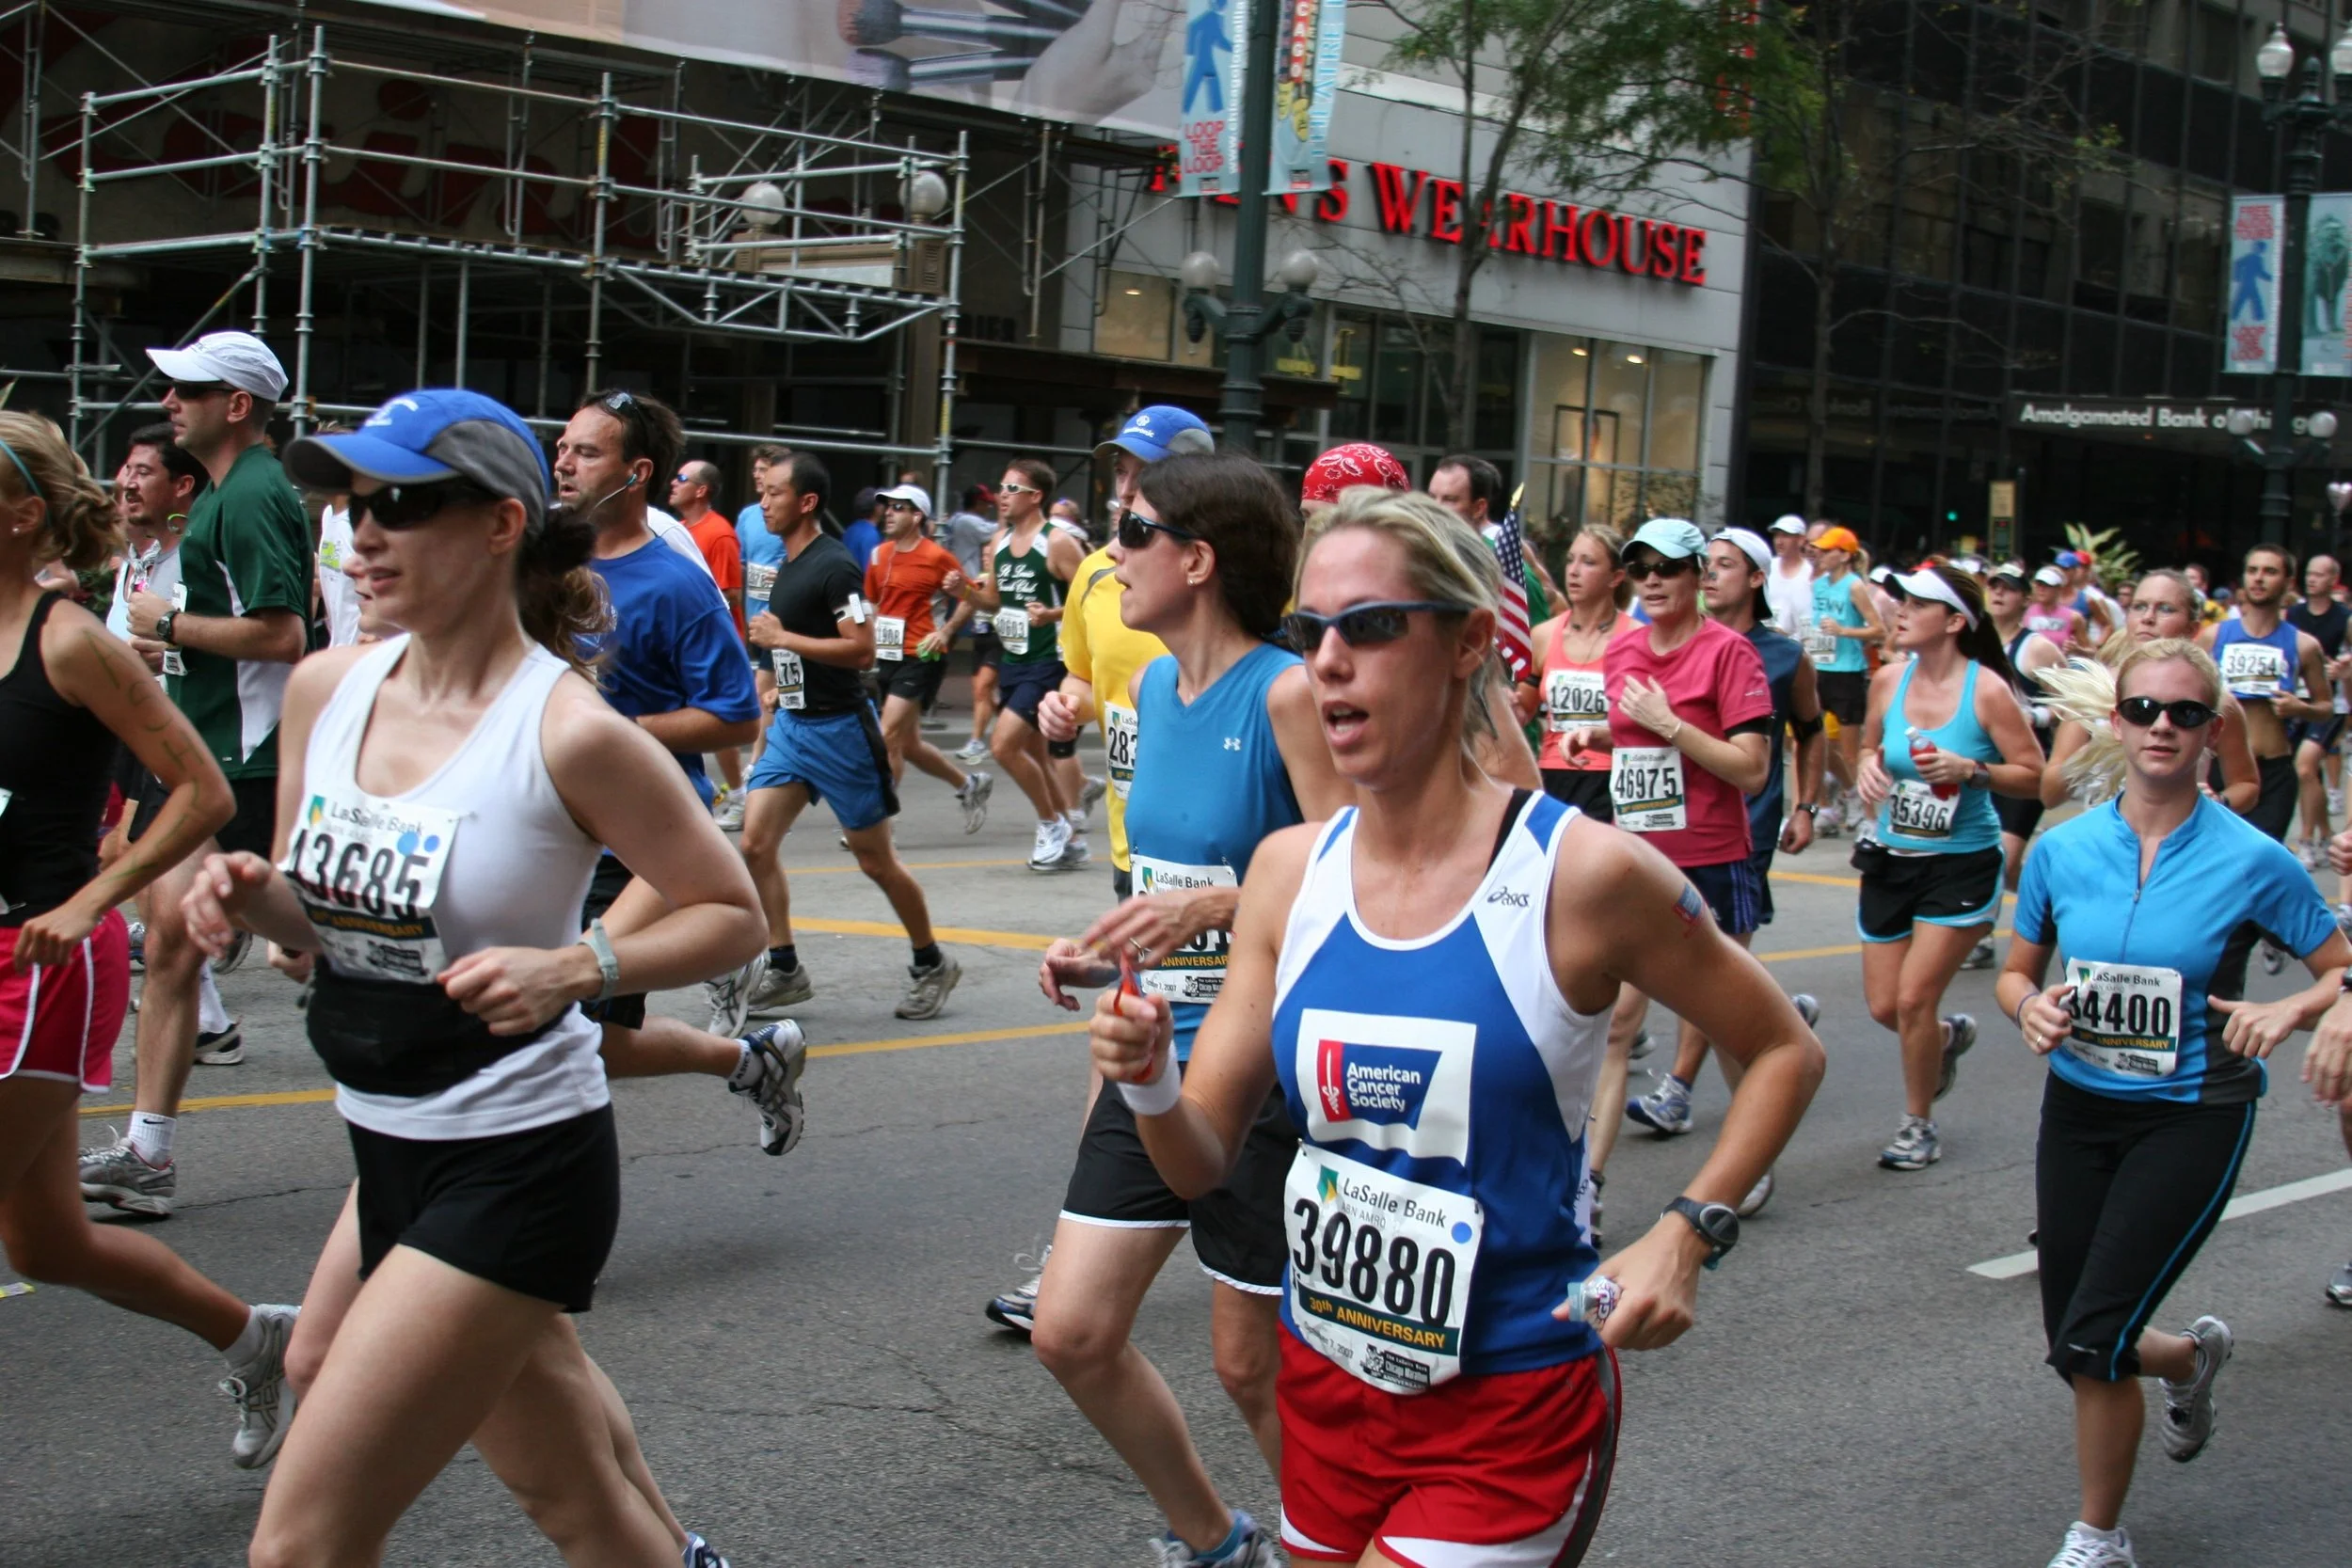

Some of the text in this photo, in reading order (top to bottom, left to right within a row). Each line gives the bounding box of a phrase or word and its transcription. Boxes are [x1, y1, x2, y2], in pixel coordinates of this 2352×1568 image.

[1184, 120, 1225, 139] LOOP
[1190, 137, 1218, 155] THE
[1184, 155, 1225, 174] LOOP
[2021, 404, 2153, 428] Amalgamated
[2158, 407, 2207, 428] Bank
[2226, 655, 2276, 675] 39254
[1550, 686, 1605, 713] 12026
[1614, 767, 1677, 799] 46975
[1890, 794, 1949, 831] 35396
[387, 818, 424, 835] Bank
[1155, 870, 1216, 888] LaSalle Bank
[2092, 972, 2161, 987] LaSalle Bank
[2096, 1037, 2169, 1050] ANNIVERSARY
[1346, 1061, 1421, 1085] American
[1346, 1078, 1402, 1097] Cancer
[1349, 1092, 1406, 1113] Society
[1343, 1178, 1448, 1228] LaSalle Bank
[1359, 1209, 1387, 1230] AMRO
[1293, 1197, 1455, 1327] 39880
[1309, 1296, 1333, 1314] 30th
[1336, 1307, 1446, 1348] ANNIVERSARY
